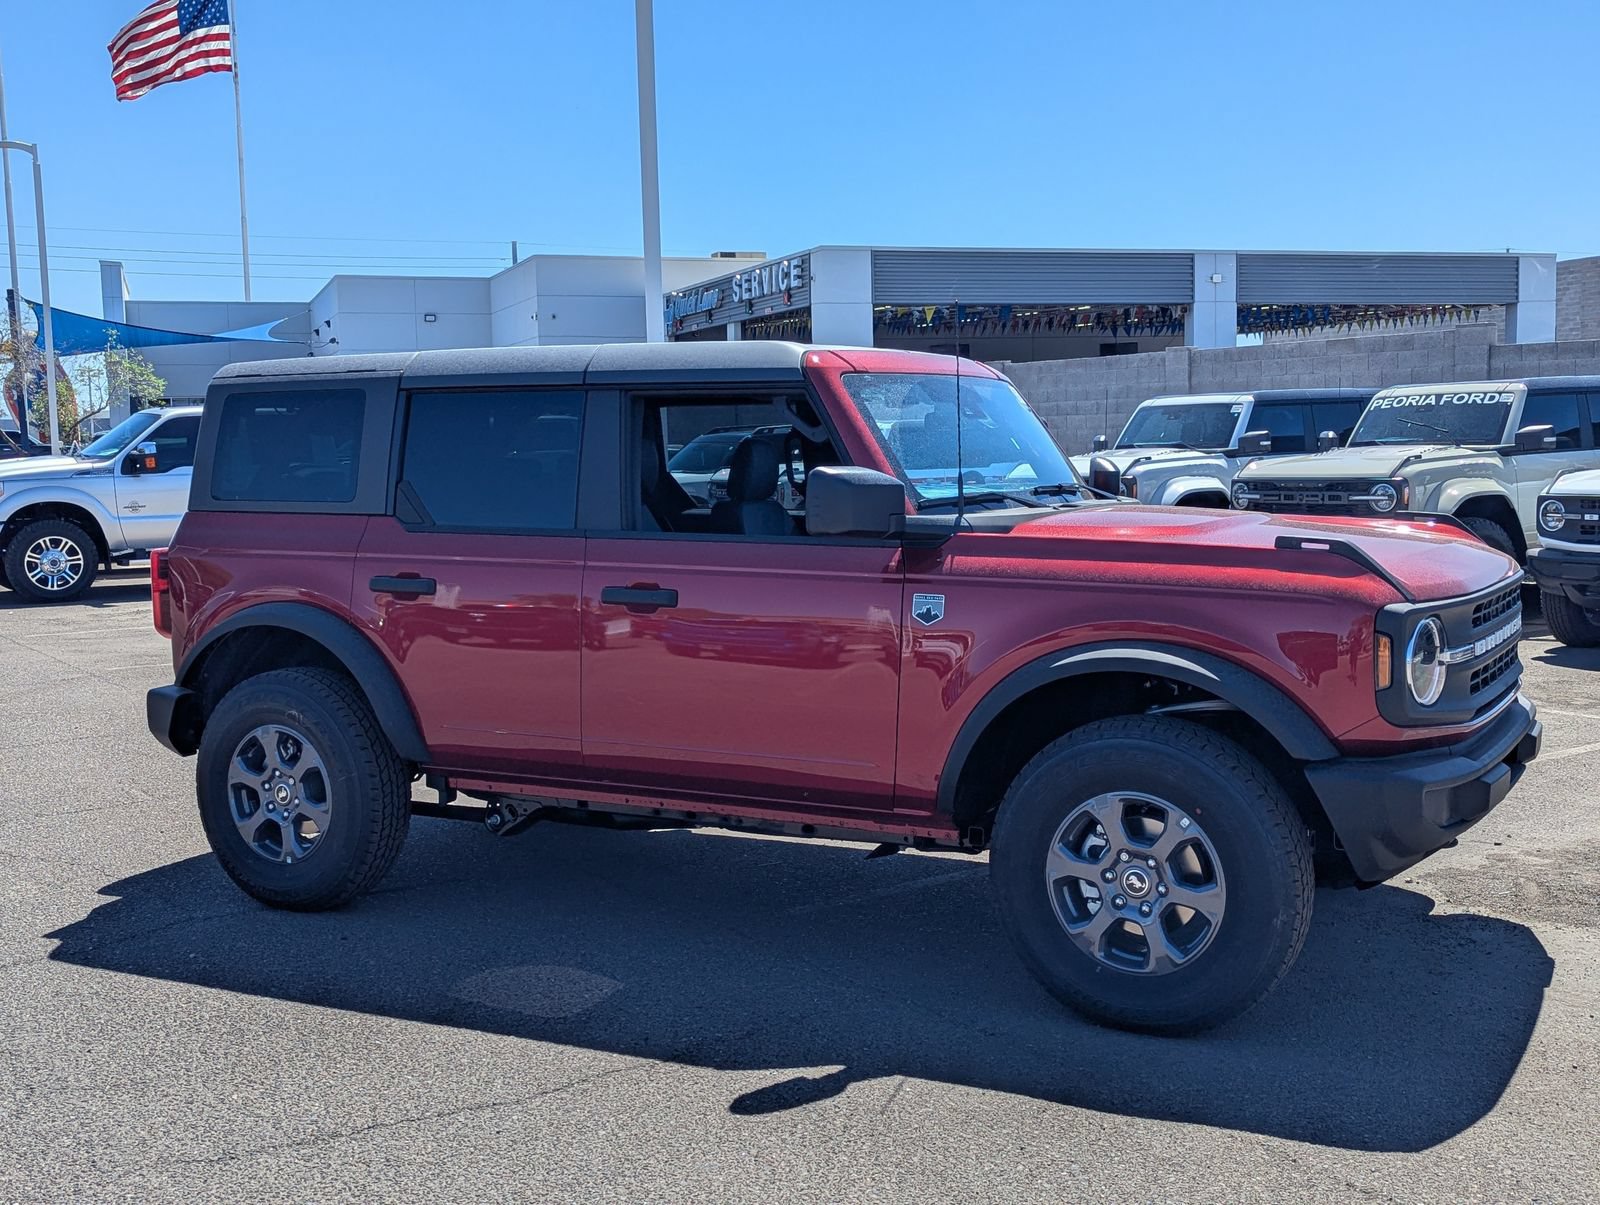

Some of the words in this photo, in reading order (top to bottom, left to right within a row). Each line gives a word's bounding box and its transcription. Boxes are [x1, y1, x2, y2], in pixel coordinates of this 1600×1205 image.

[732, 258, 801, 303] SERVICE
[1370, 394, 1436, 410] PEORIA
[1439, 393, 1499, 405] FORD
